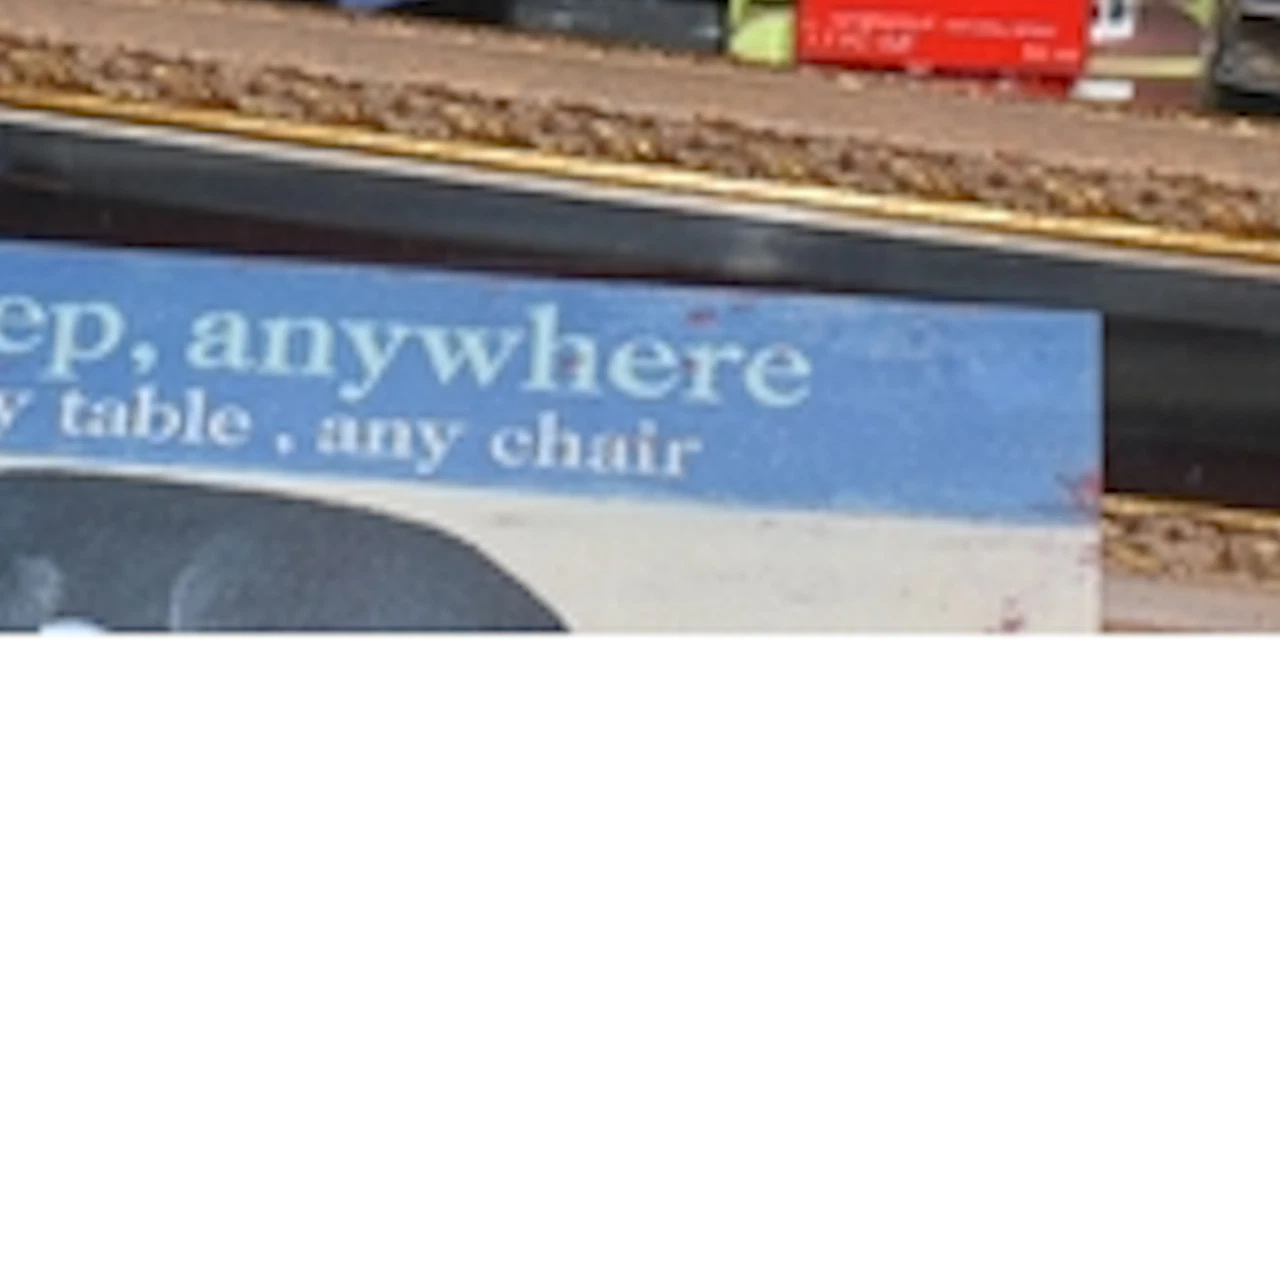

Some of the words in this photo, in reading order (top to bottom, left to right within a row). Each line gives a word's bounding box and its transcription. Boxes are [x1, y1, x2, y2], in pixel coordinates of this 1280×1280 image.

[185, 302, 814, 408] anywhere
[59, 384, 253, 446] table
[316, 412, 467, 475] any
[489, 410, 702, 478] chair
